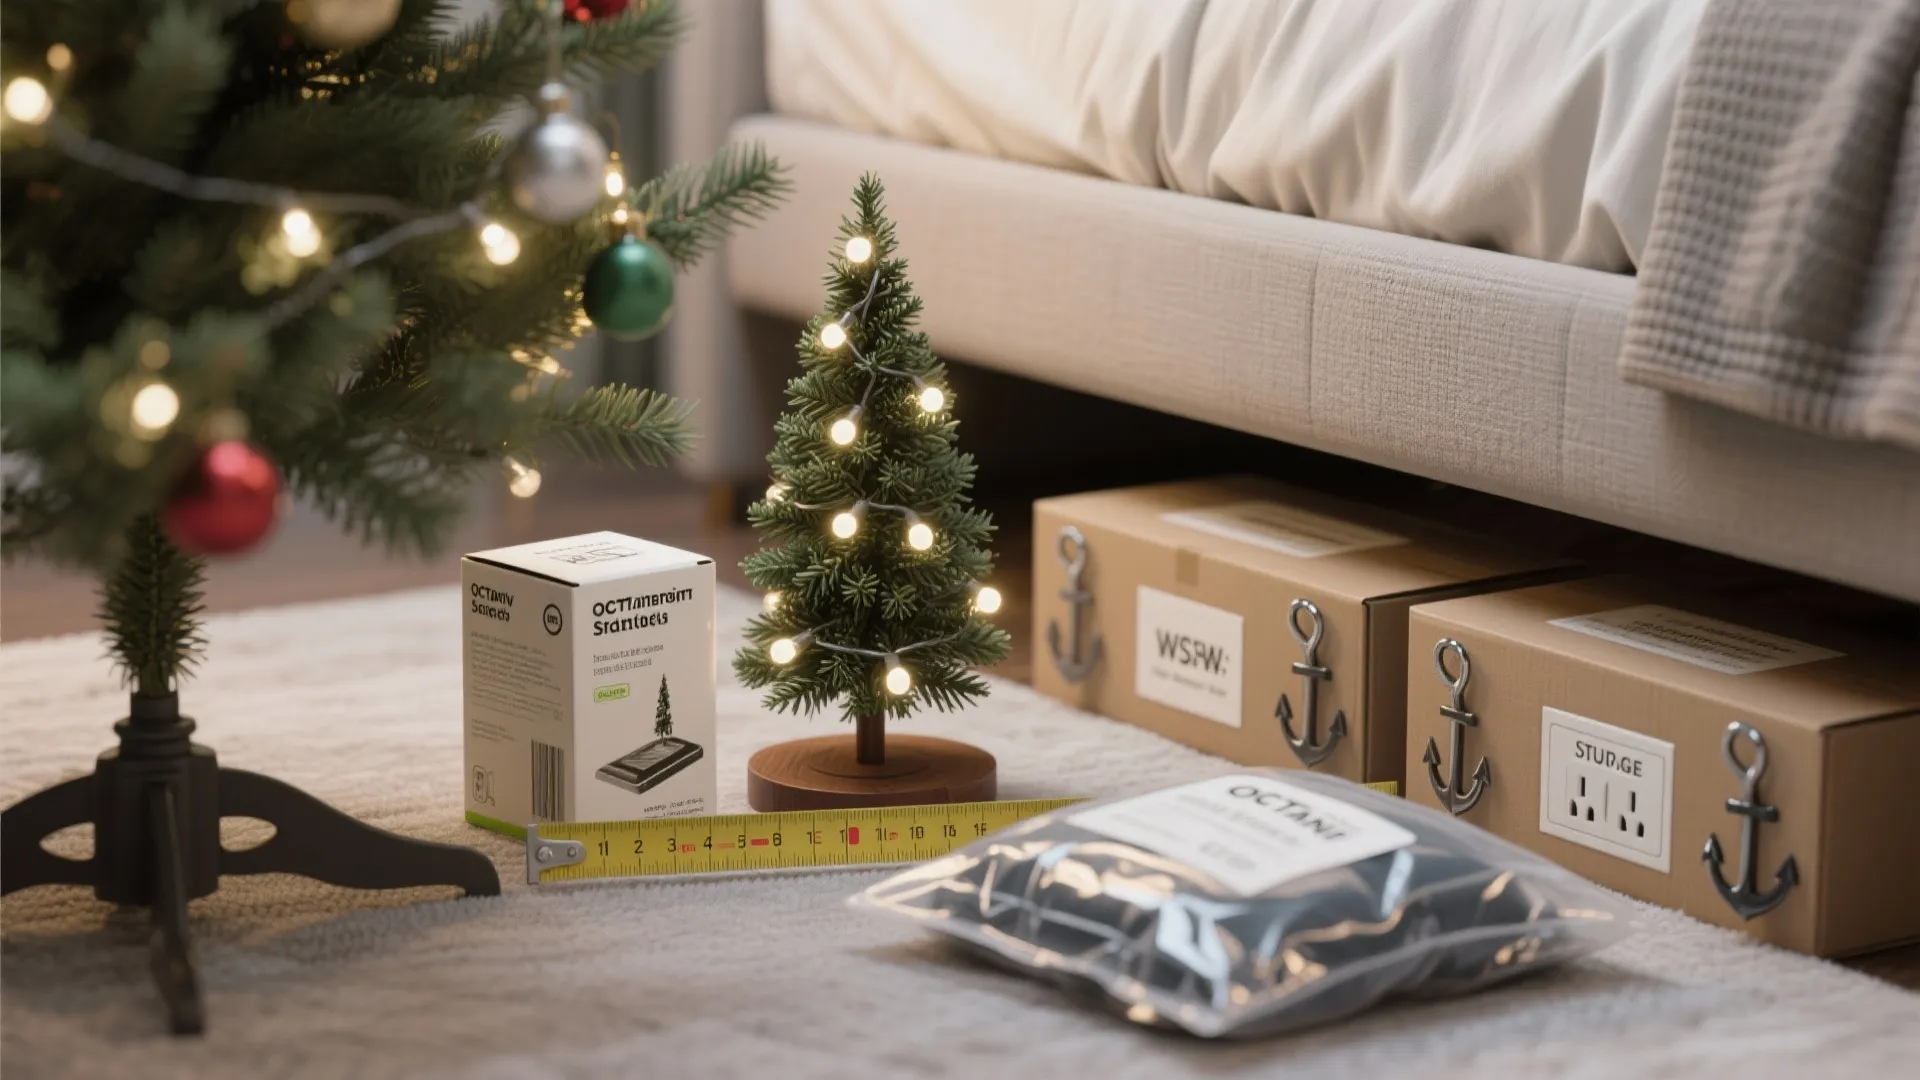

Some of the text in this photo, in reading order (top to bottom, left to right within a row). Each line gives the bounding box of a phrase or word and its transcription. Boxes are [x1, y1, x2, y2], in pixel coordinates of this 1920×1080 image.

[634, 839, 644, 854] 2
[667, 838, 677, 852] 3
[703, 836, 713, 850] 4
